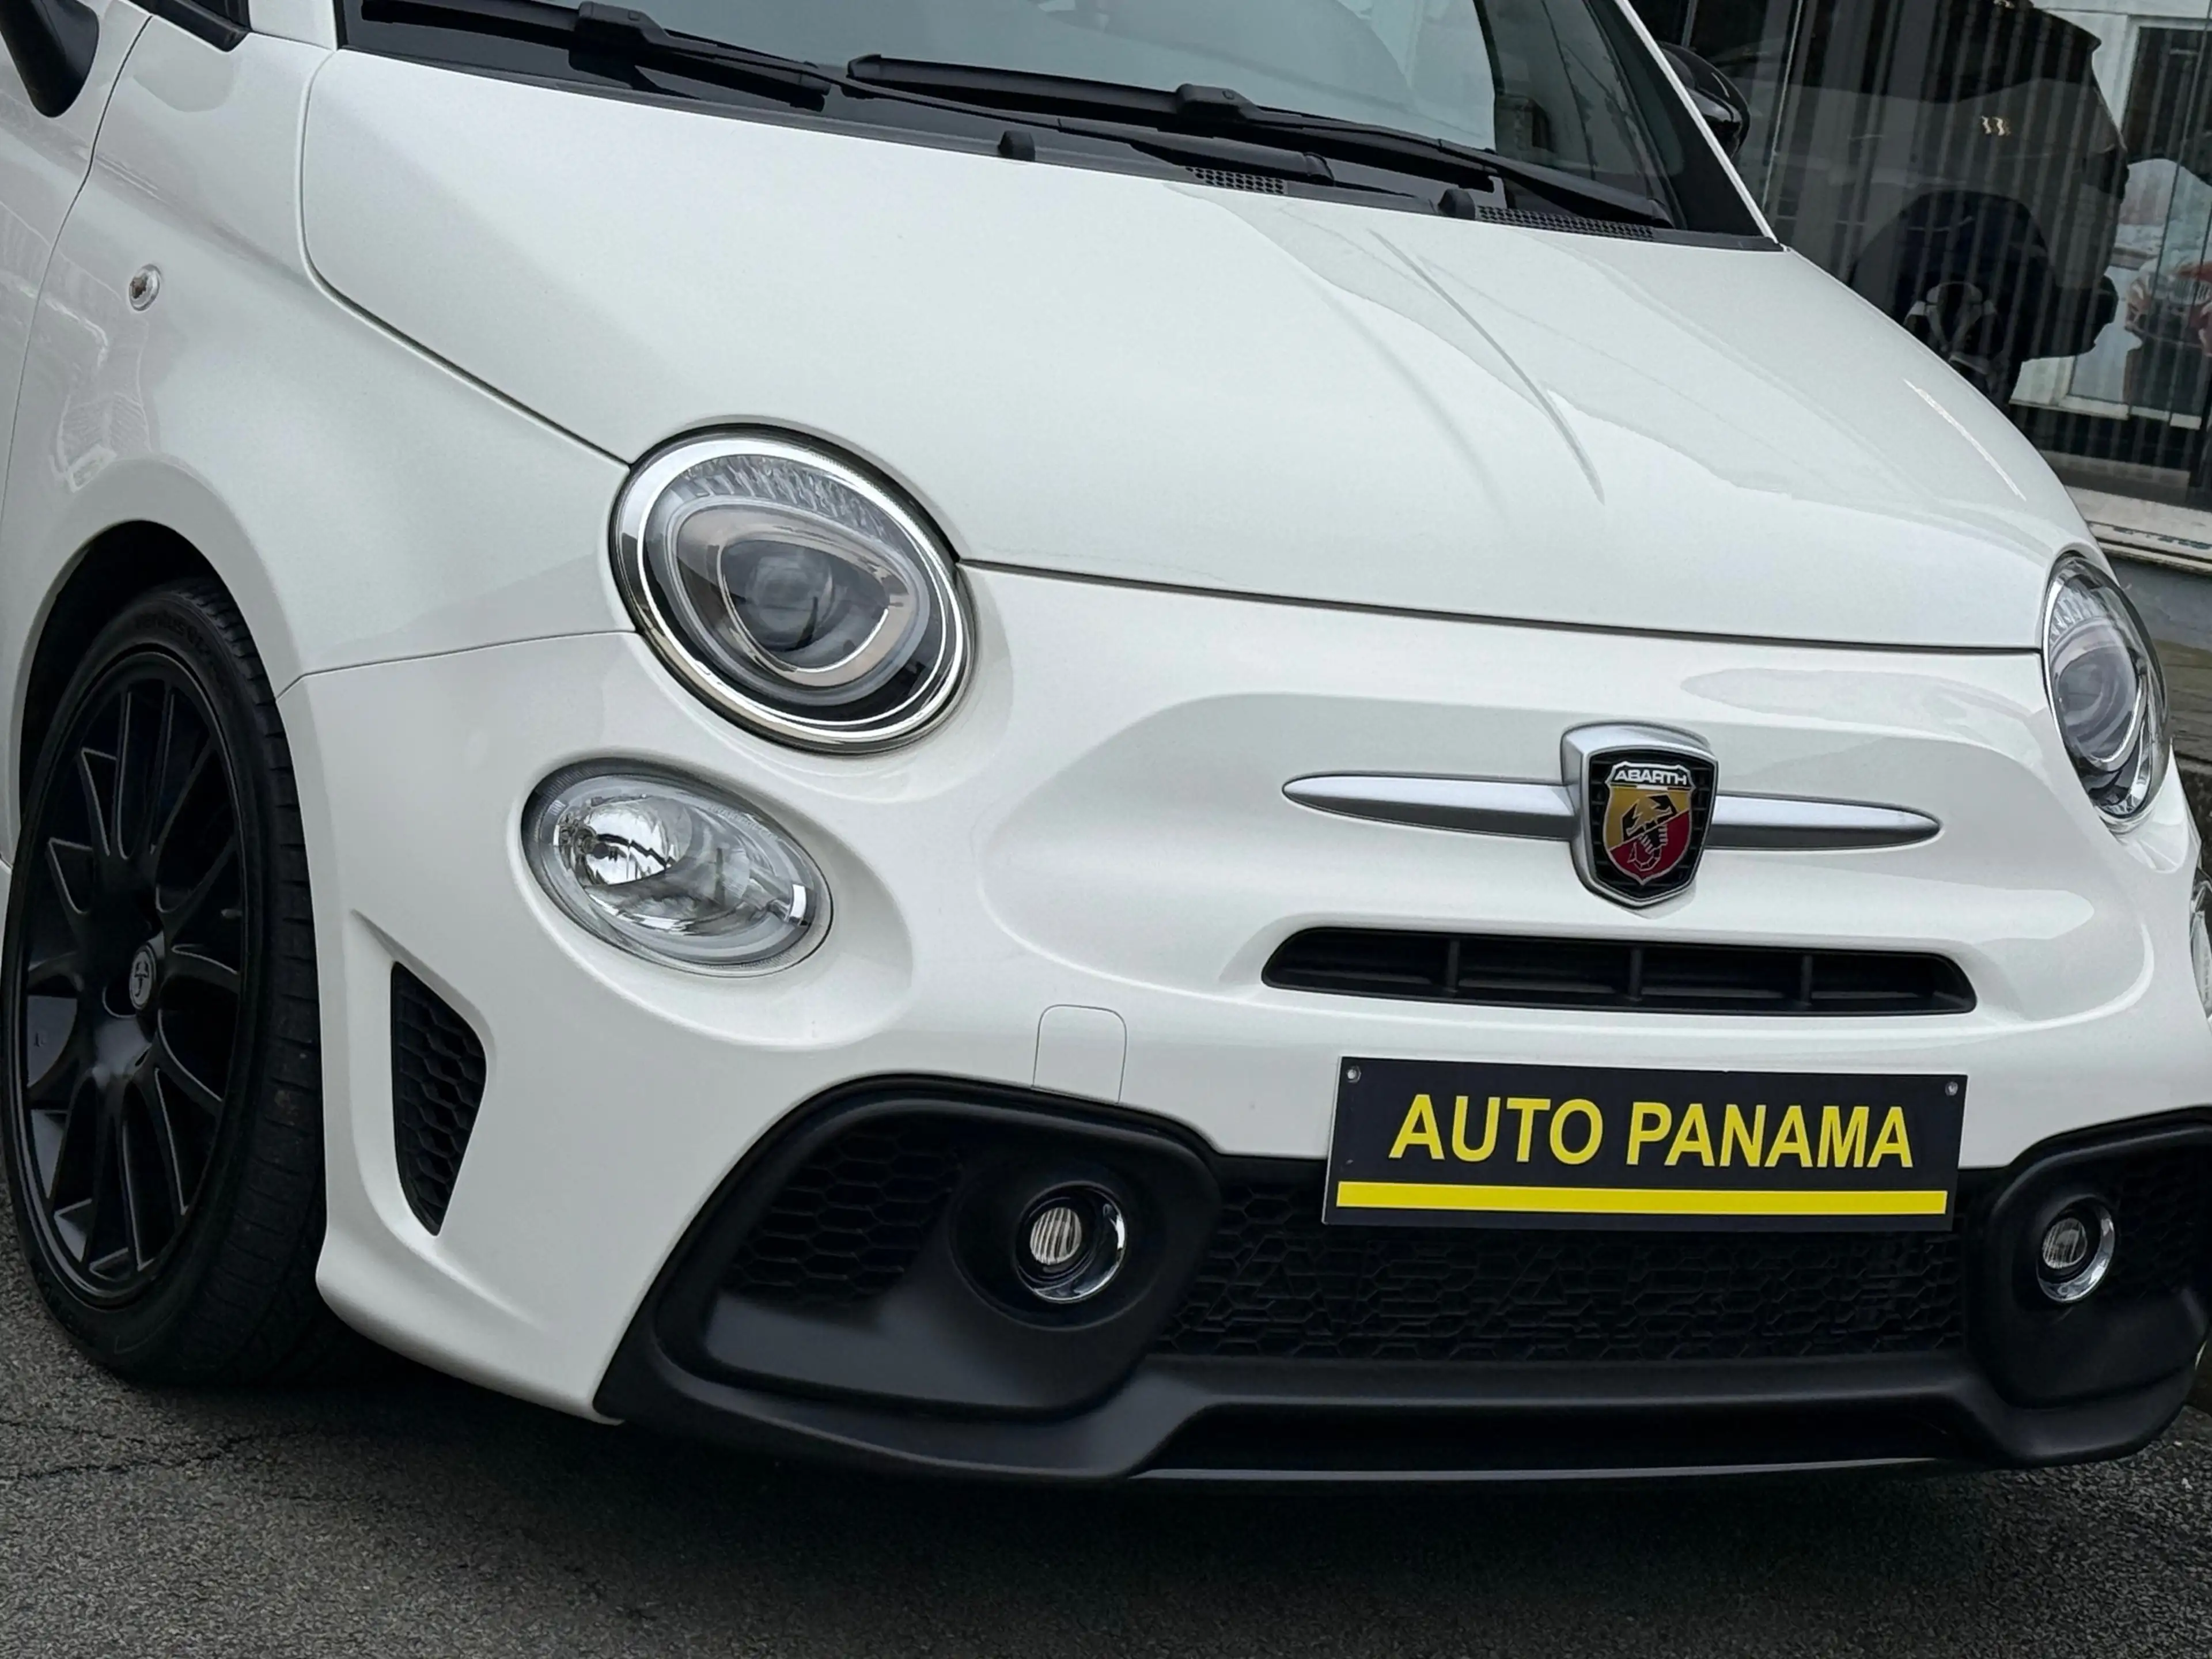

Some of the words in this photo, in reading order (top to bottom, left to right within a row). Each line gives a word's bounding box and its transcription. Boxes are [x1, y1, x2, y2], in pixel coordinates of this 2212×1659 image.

[1615, 769, 1687, 785] ABARTH
[1389, 1094, 1604, 1165] AUTO
[1627, 1101, 1912, 1166] PANAMA
